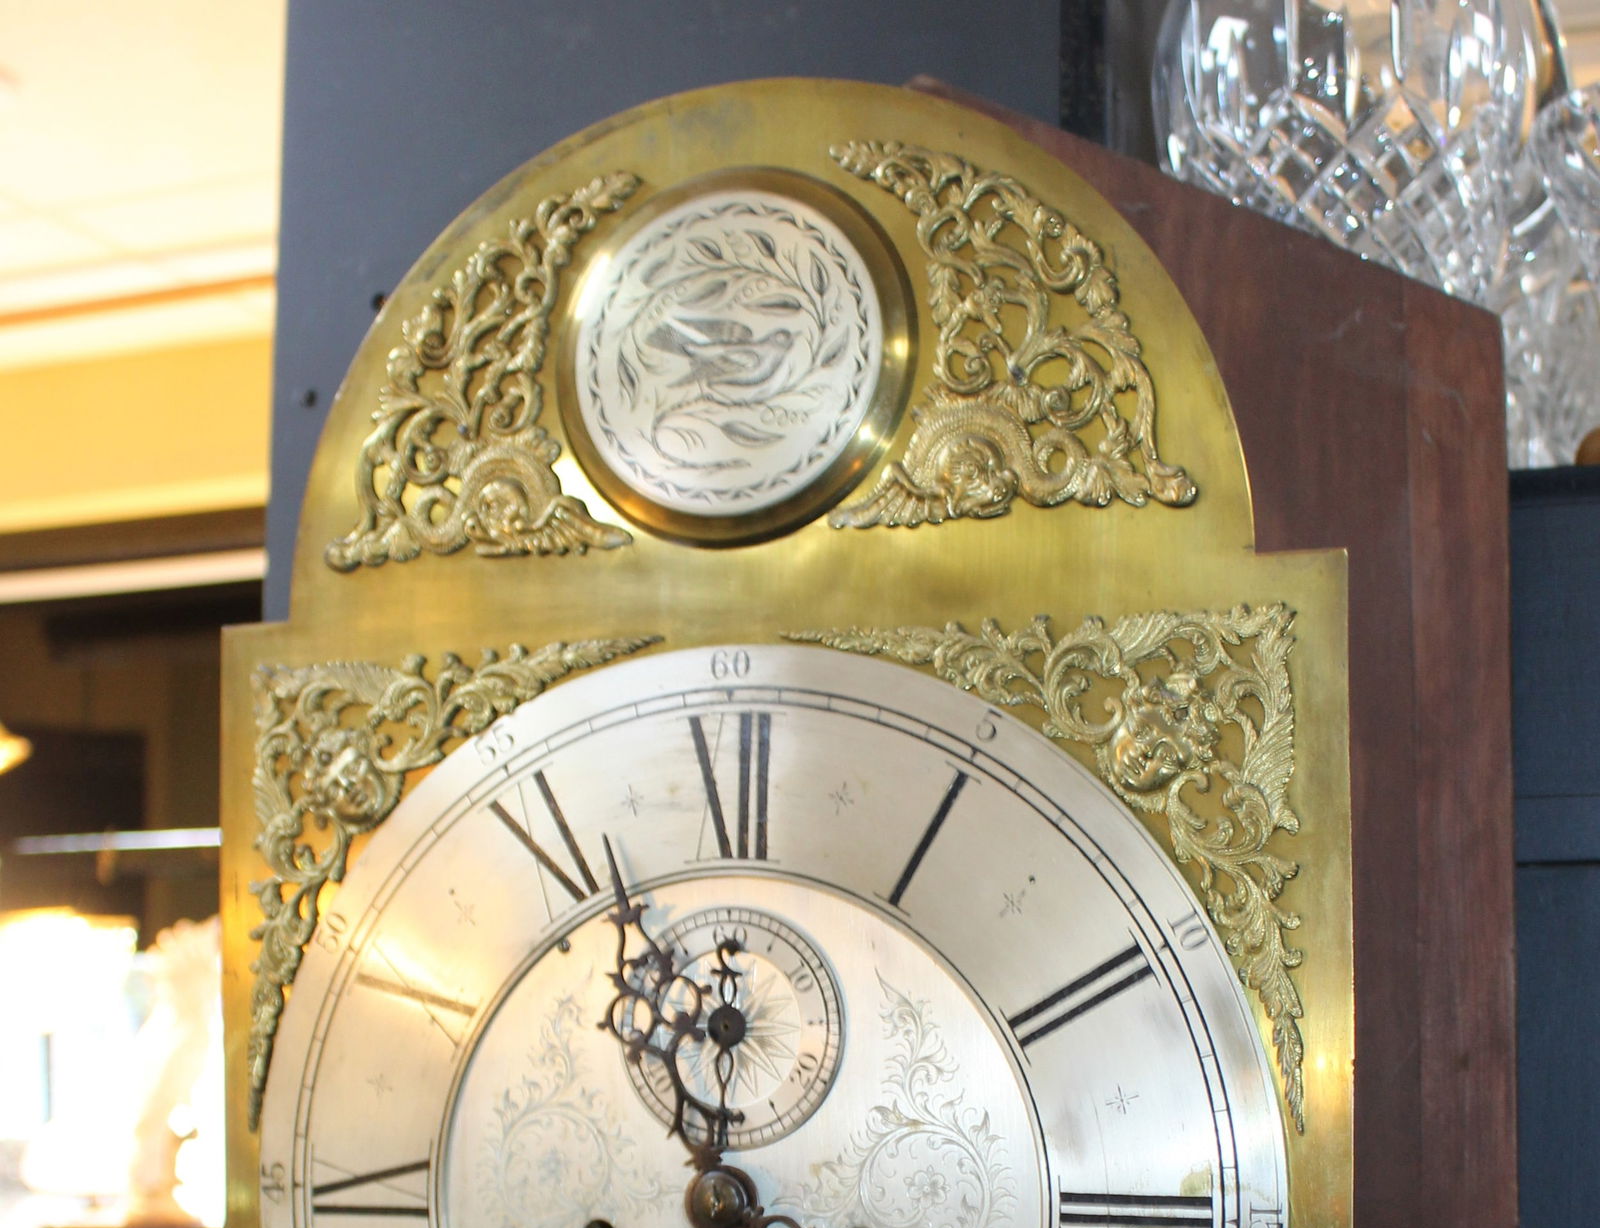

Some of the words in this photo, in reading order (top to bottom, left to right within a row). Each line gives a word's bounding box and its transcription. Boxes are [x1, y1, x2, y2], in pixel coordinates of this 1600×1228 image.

[710, 649, 751, 679] 60
[474, 723, 516, 766] 55
[976, 709, 1003, 743] 5
[684, 710, 776, 862] XII
[478, 763, 600, 930] XI
[316, 911, 350, 955] 50
[1165, 905, 1210, 952] 10
[352, 930, 485, 1060] X
[786, 960, 815, 994] 10
[1000, 926, 1162, 1066] II
[788, 1051, 820, 1087] 20
[260, 1162, 286, 1203] 45
